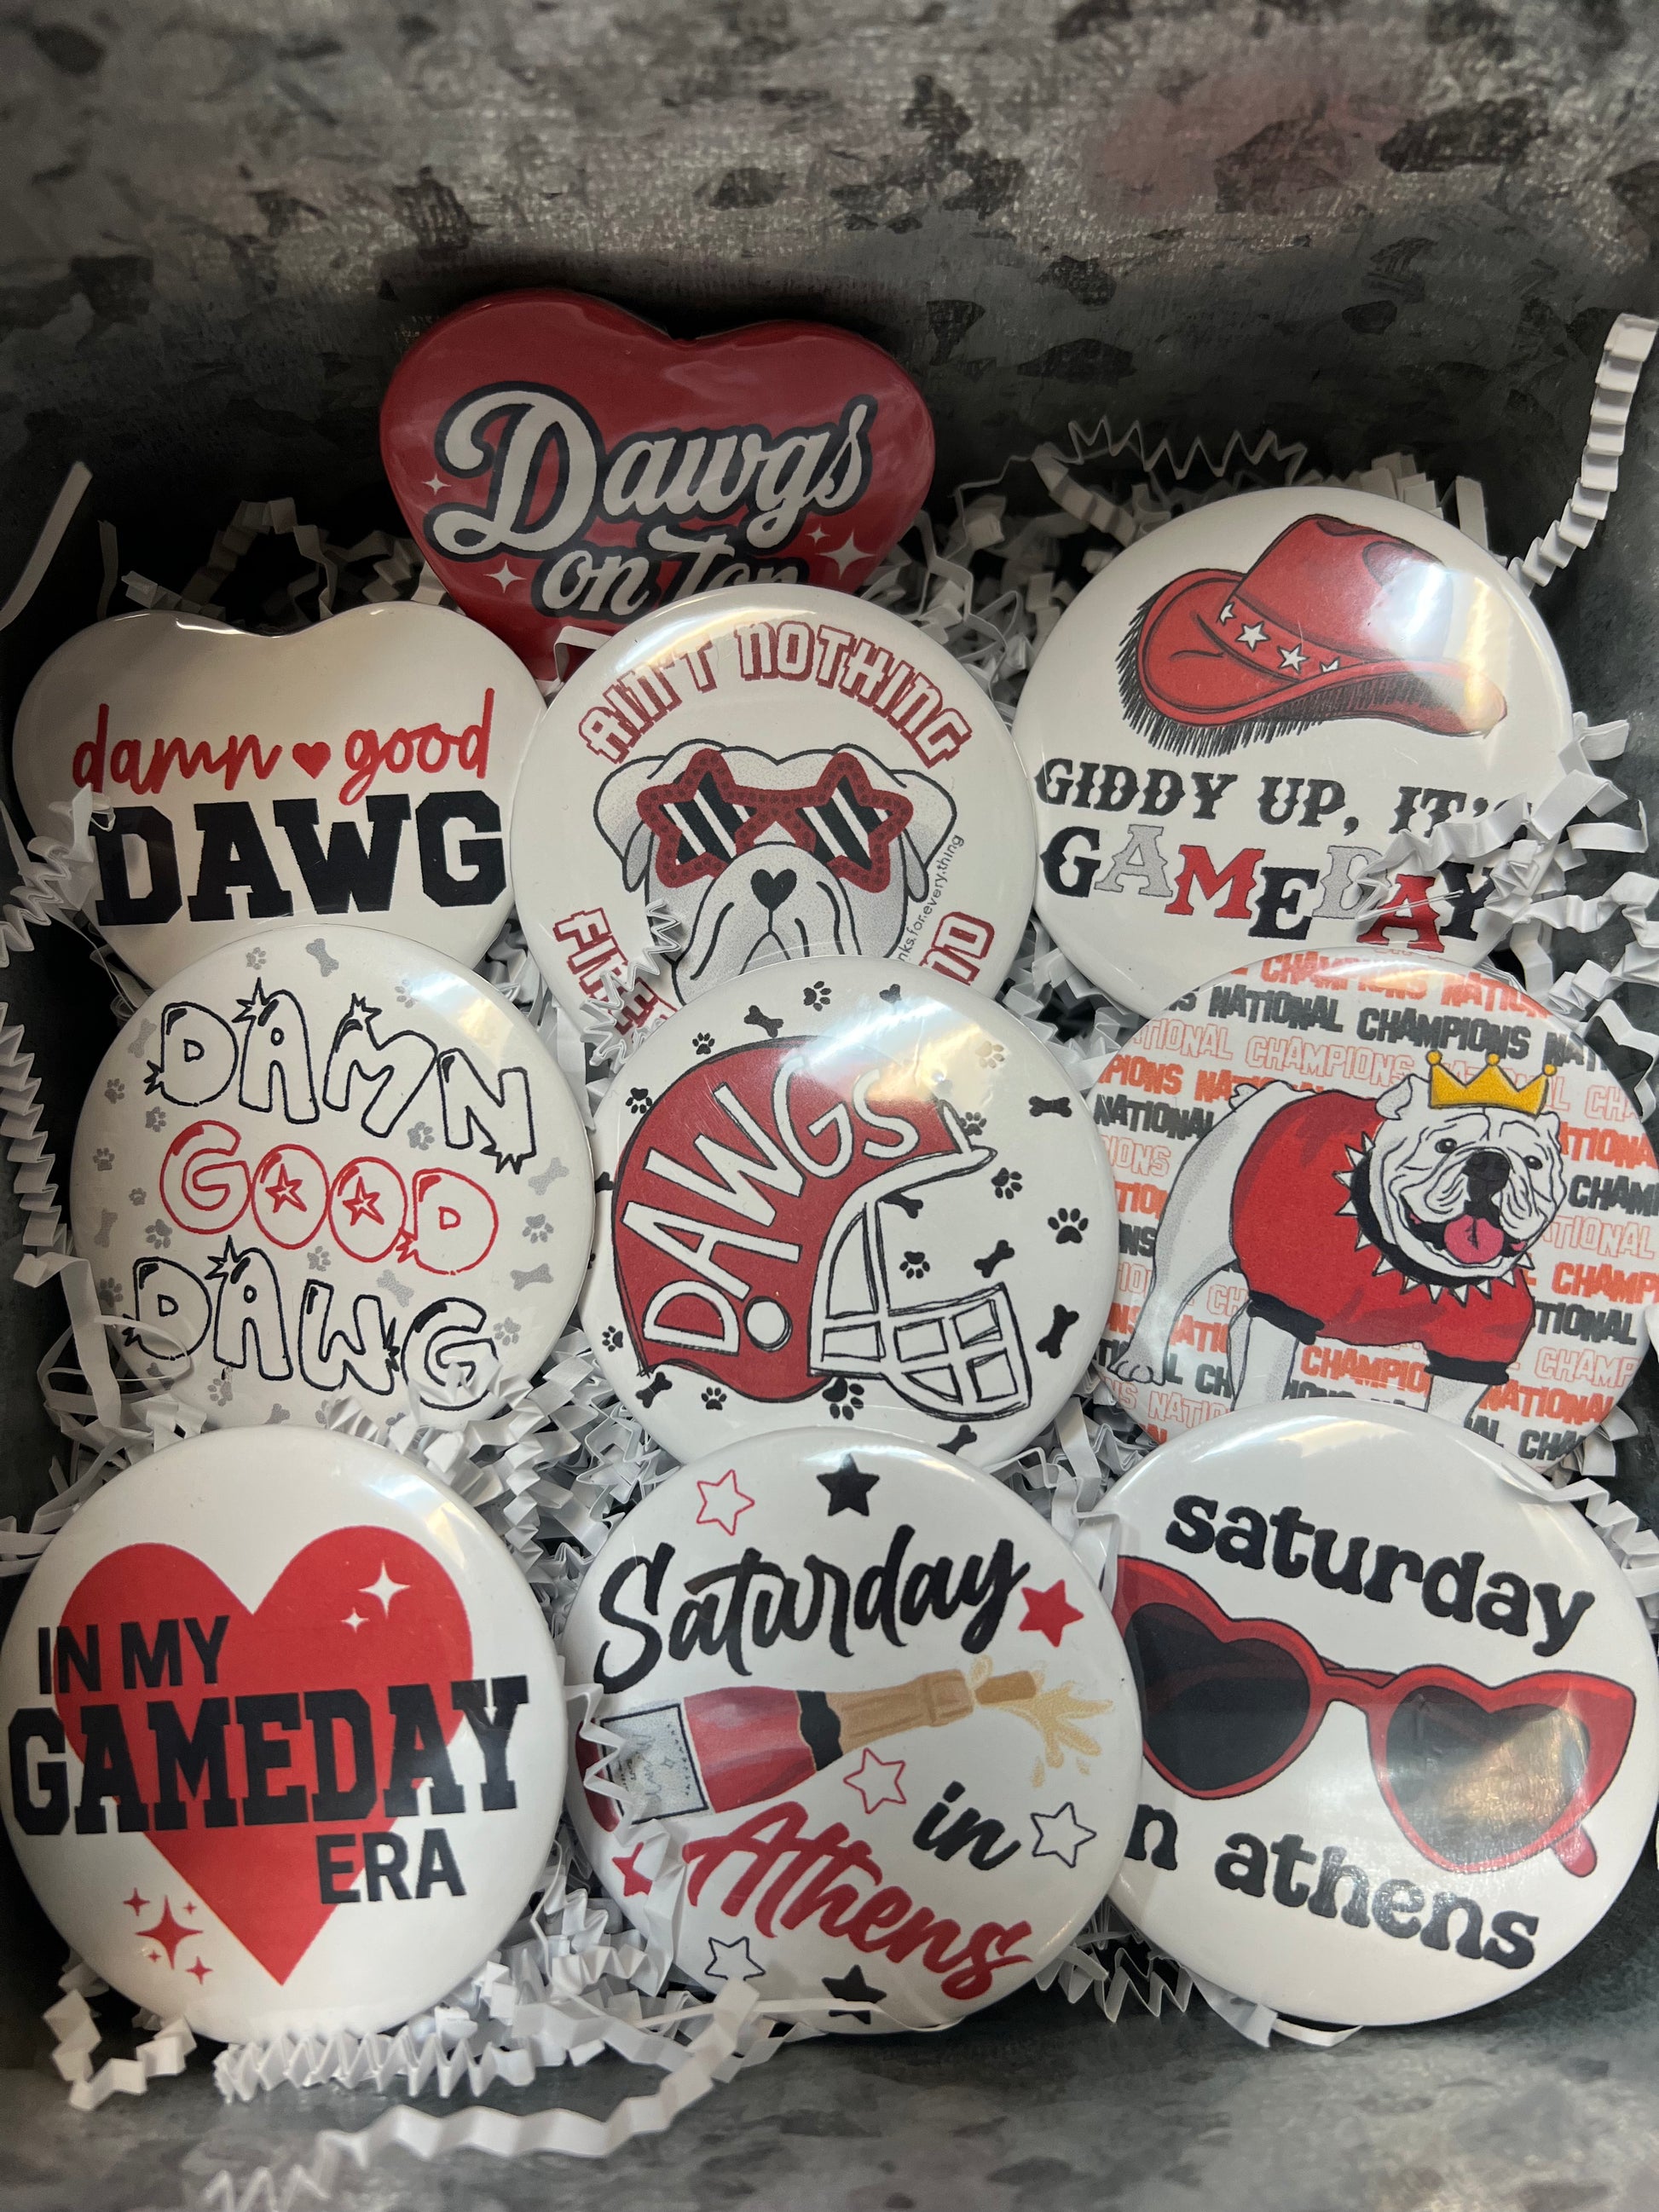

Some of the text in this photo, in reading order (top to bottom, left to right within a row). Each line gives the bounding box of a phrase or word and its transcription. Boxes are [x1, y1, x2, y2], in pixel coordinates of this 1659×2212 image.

[426, 384, 875, 559] Dawgs
[539, 548, 651, 617] on
[72, 688, 494, 806] damn good
[1034, 757, 1237, 820] GIDDY
[1257, 775, 1359, 836] UP,
[88, 789, 506, 927] DAWG
[1039, 823, 1498, 952] GAMEDAY
[145, 978, 536, 1174] DAMN
[1208, 984, 1344, 1033] NATIONAL
[1356, 1008, 1531, 1060] CHAMPIONS
[1245, 1036, 1415, 1088] CHAMPIONS
[159, 1119, 499, 1275] GOOD
[621, 1056, 920, 1357] DAWGS
[121, 1235, 500, 1411] DAWG
[1300, 1343, 1434, 1397] CHAMPIO
[593, 1524, 1031, 1694] Saturday
[1165, 1494, 1595, 1656] saturday
[38, 1614, 230, 1695] IN MY
[8, 1675, 529, 1835] GAMEDAY
[315, 1828, 467, 1904] ERA
[912, 1781, 1021, 1871] in
[1124, 1804, 1540, 1969] n athens
[681, 1801, 1033, 2001] Athens
